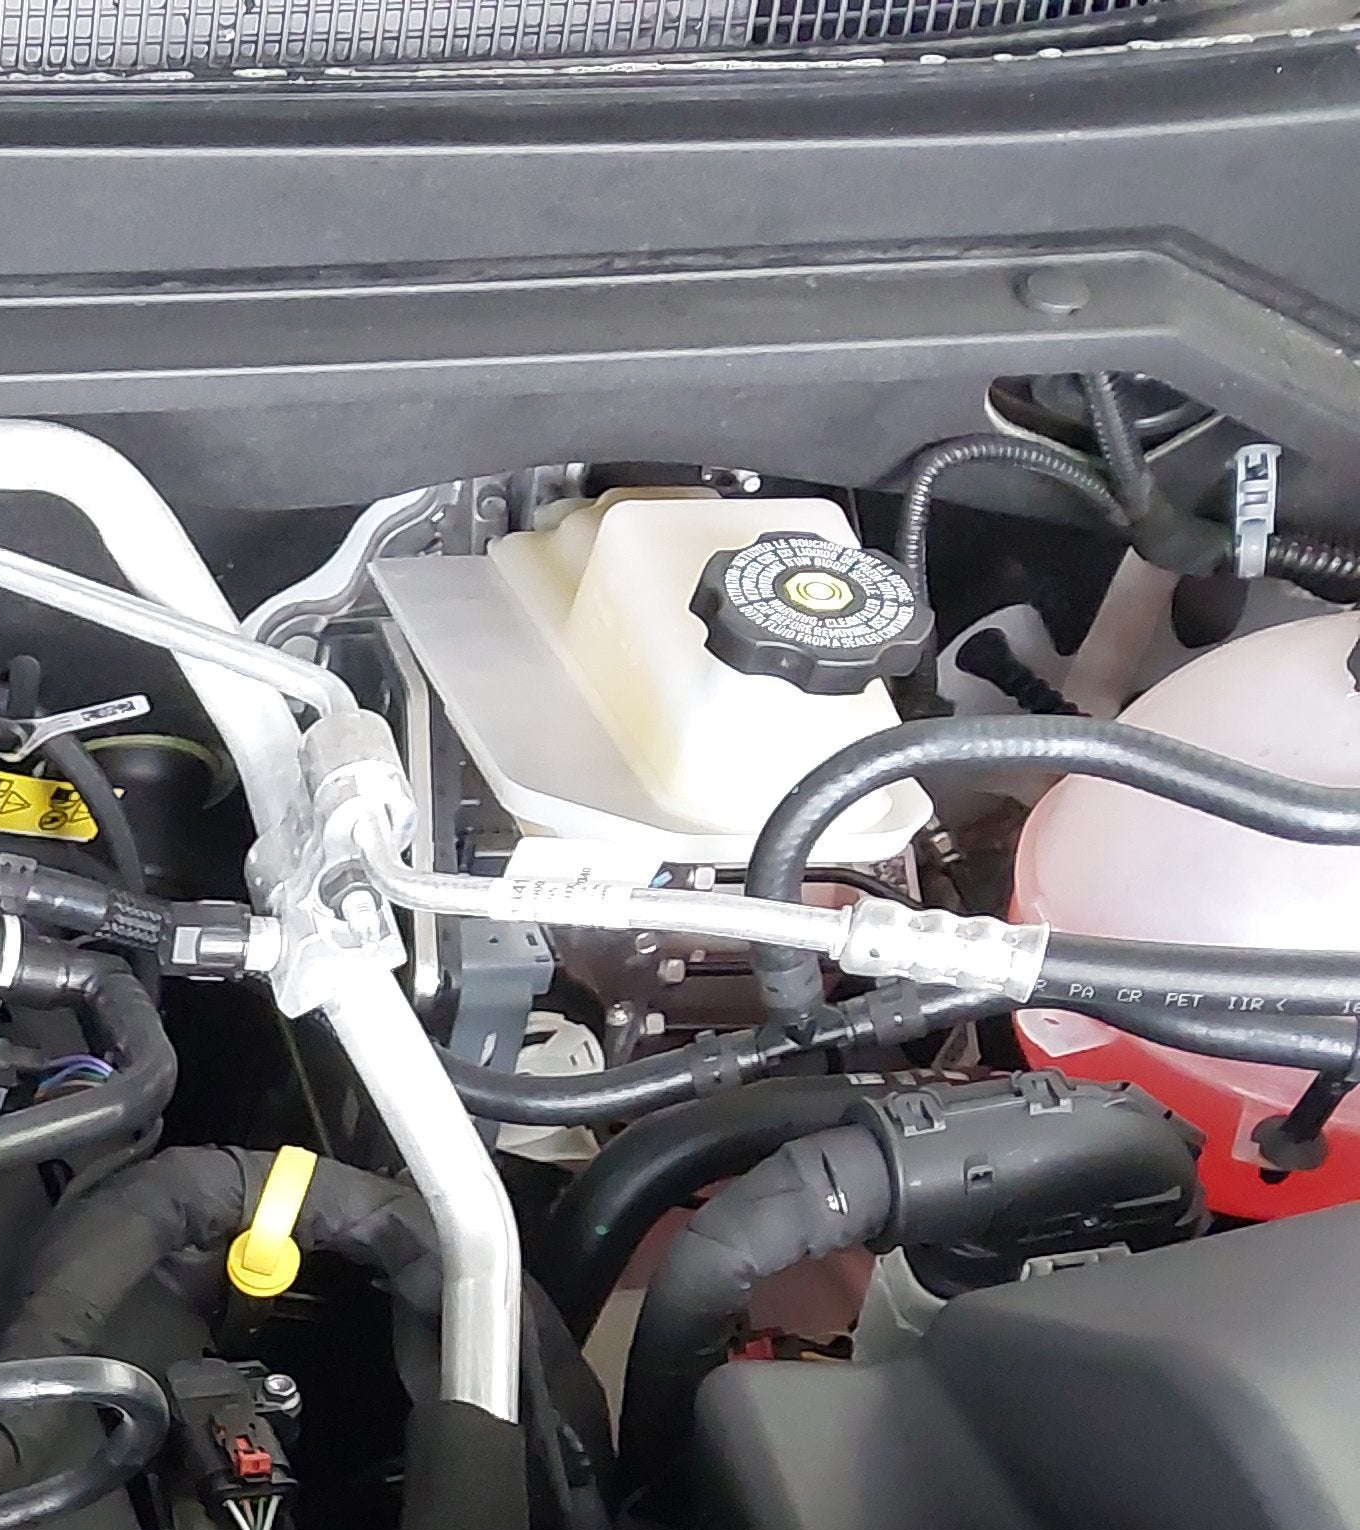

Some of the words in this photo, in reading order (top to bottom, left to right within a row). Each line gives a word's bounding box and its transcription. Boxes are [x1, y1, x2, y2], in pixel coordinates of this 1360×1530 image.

[771, 538, 791, 550] LE
[789, 538, 844, 553] BOUCHON
[878, 564, 893, 578] LA
[771, 609, 815, 633] BEFORE
[795, 634, 831, 648] FROM
[831, 638, 843, 649] A
[1069, 983, 1095, 999] PA
[1116, 988, 1144, 1004] CR
[1164, 992, 1204, 1008] PET
